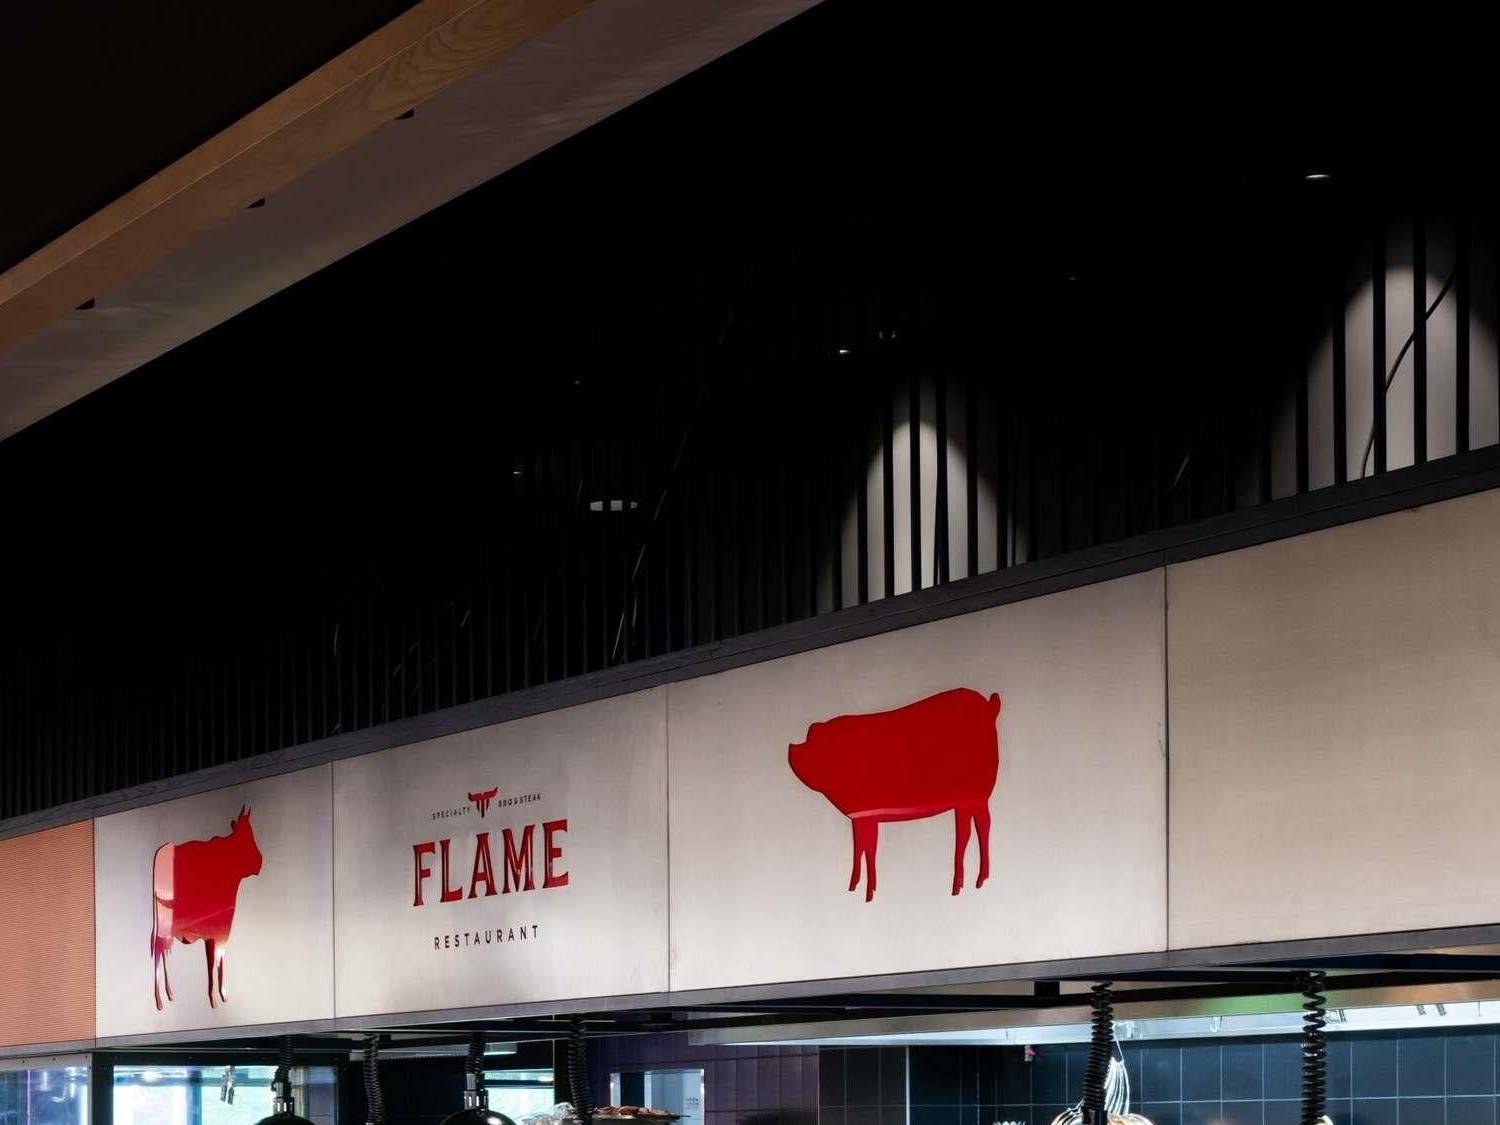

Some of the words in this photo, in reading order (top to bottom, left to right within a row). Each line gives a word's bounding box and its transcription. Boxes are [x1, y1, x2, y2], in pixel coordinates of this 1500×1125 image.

[432, 807, 471, 820] SPECIALTY
[412, 819, 569, 906] FLAME
[434, 925, 539, 949] RESTAURANT
